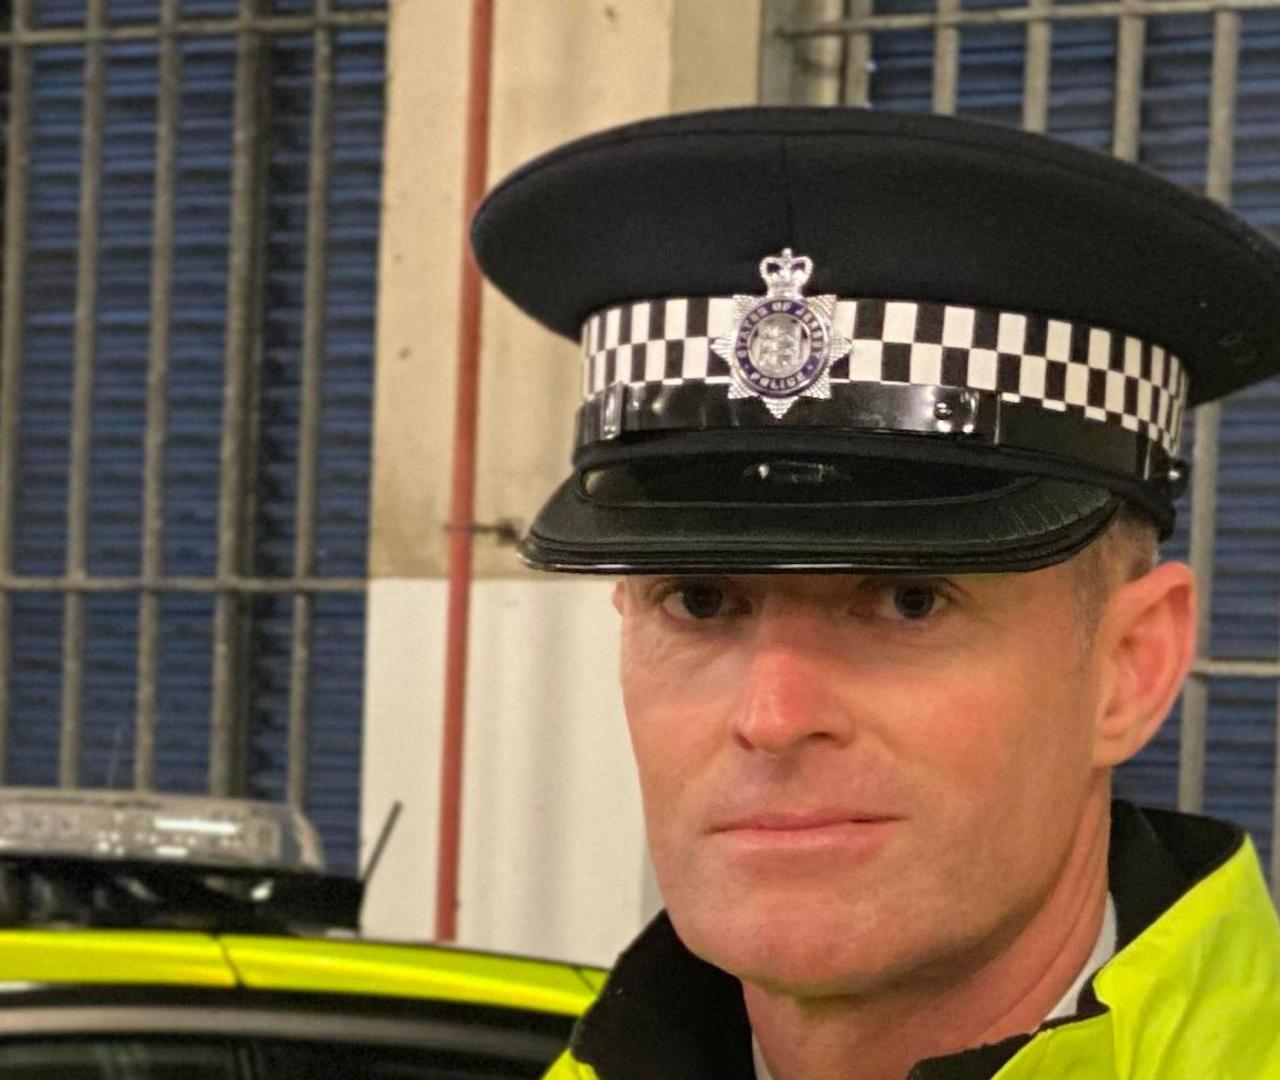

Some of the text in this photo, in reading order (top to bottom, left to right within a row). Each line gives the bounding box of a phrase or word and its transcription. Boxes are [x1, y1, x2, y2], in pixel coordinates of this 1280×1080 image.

[736, 302, 823, 360] STATES OF JERSEY
[750, 371, 806, 389] POLICE
